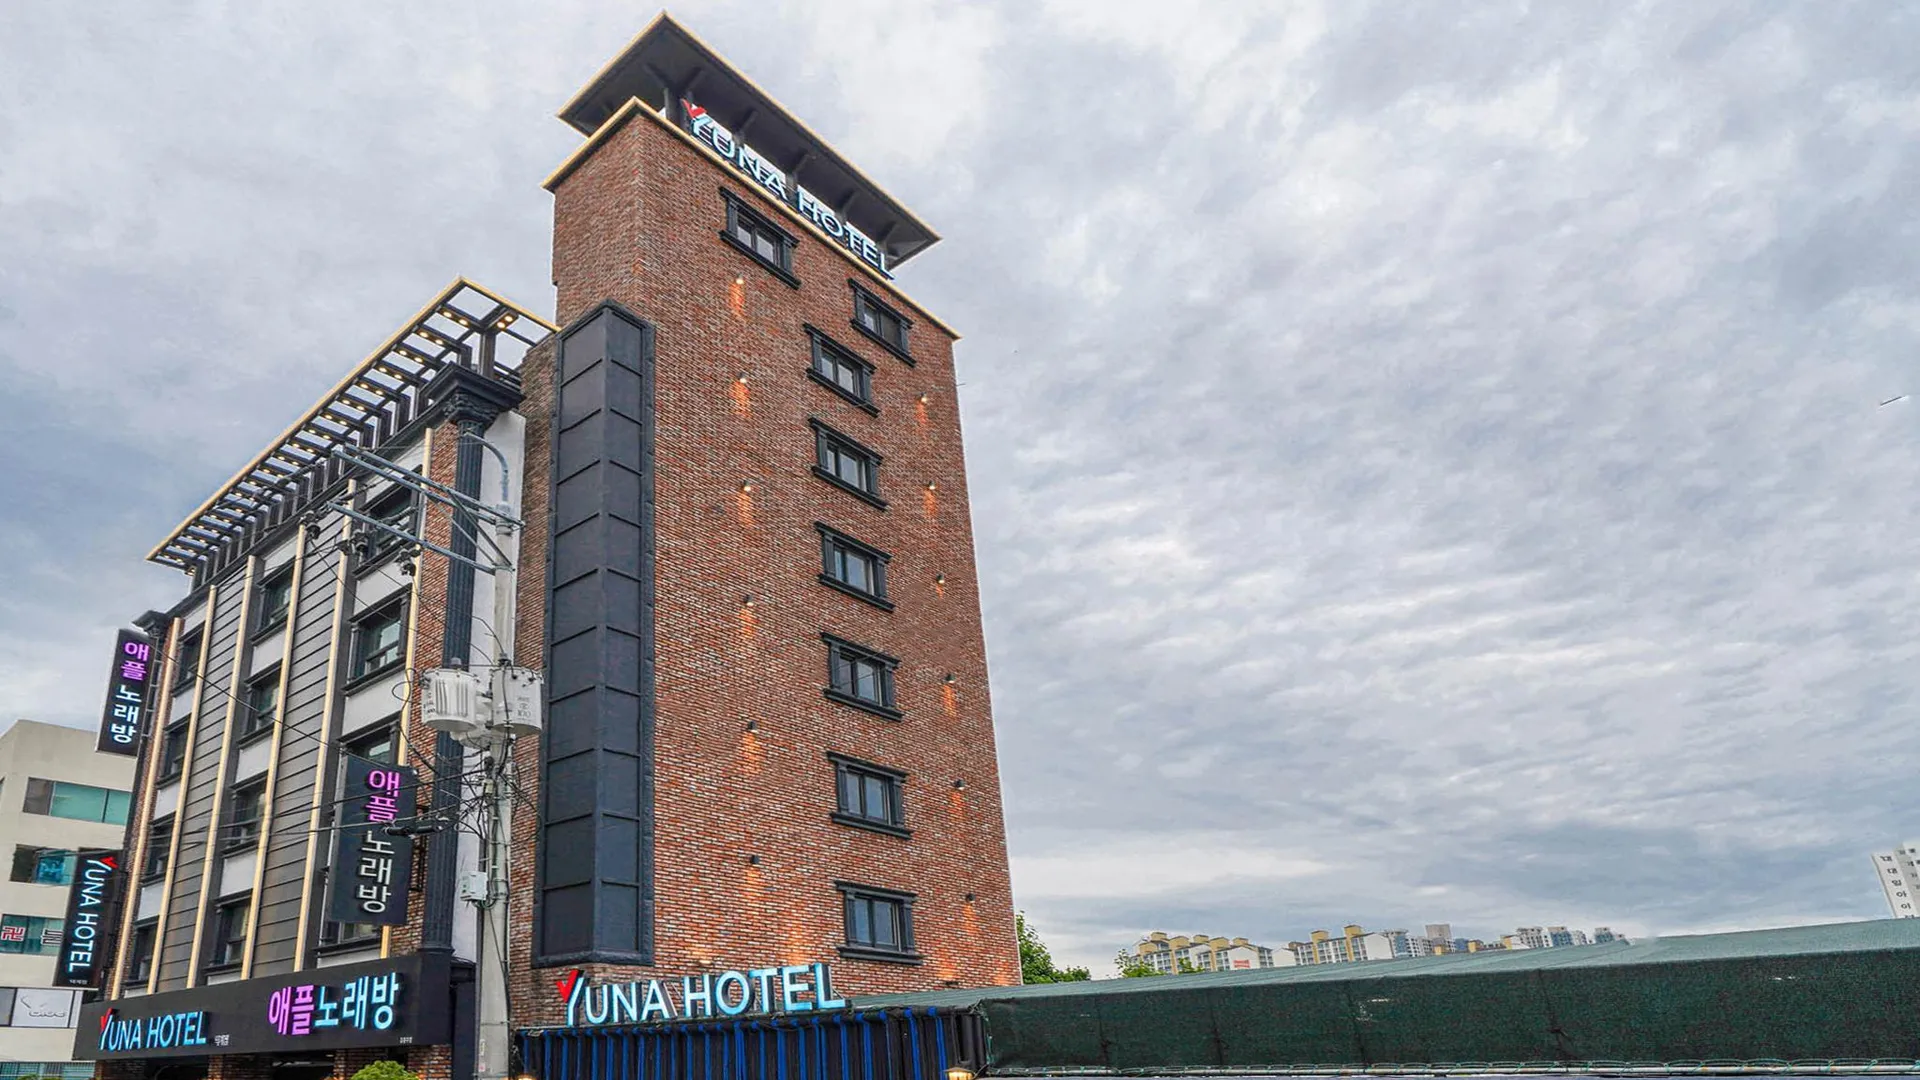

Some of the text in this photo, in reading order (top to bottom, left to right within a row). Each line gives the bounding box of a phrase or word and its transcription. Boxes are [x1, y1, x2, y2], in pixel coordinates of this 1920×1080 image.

[681, 98, 894, 280] YUNA HOTEL
[79, 855, 118, 907] YUNA
[68, 912, 99, 973] HOTEL
[556, 963, 846, 1026] YUNA HOTEL
[99, 1007, 207, 1050] YUNA HOTEL
